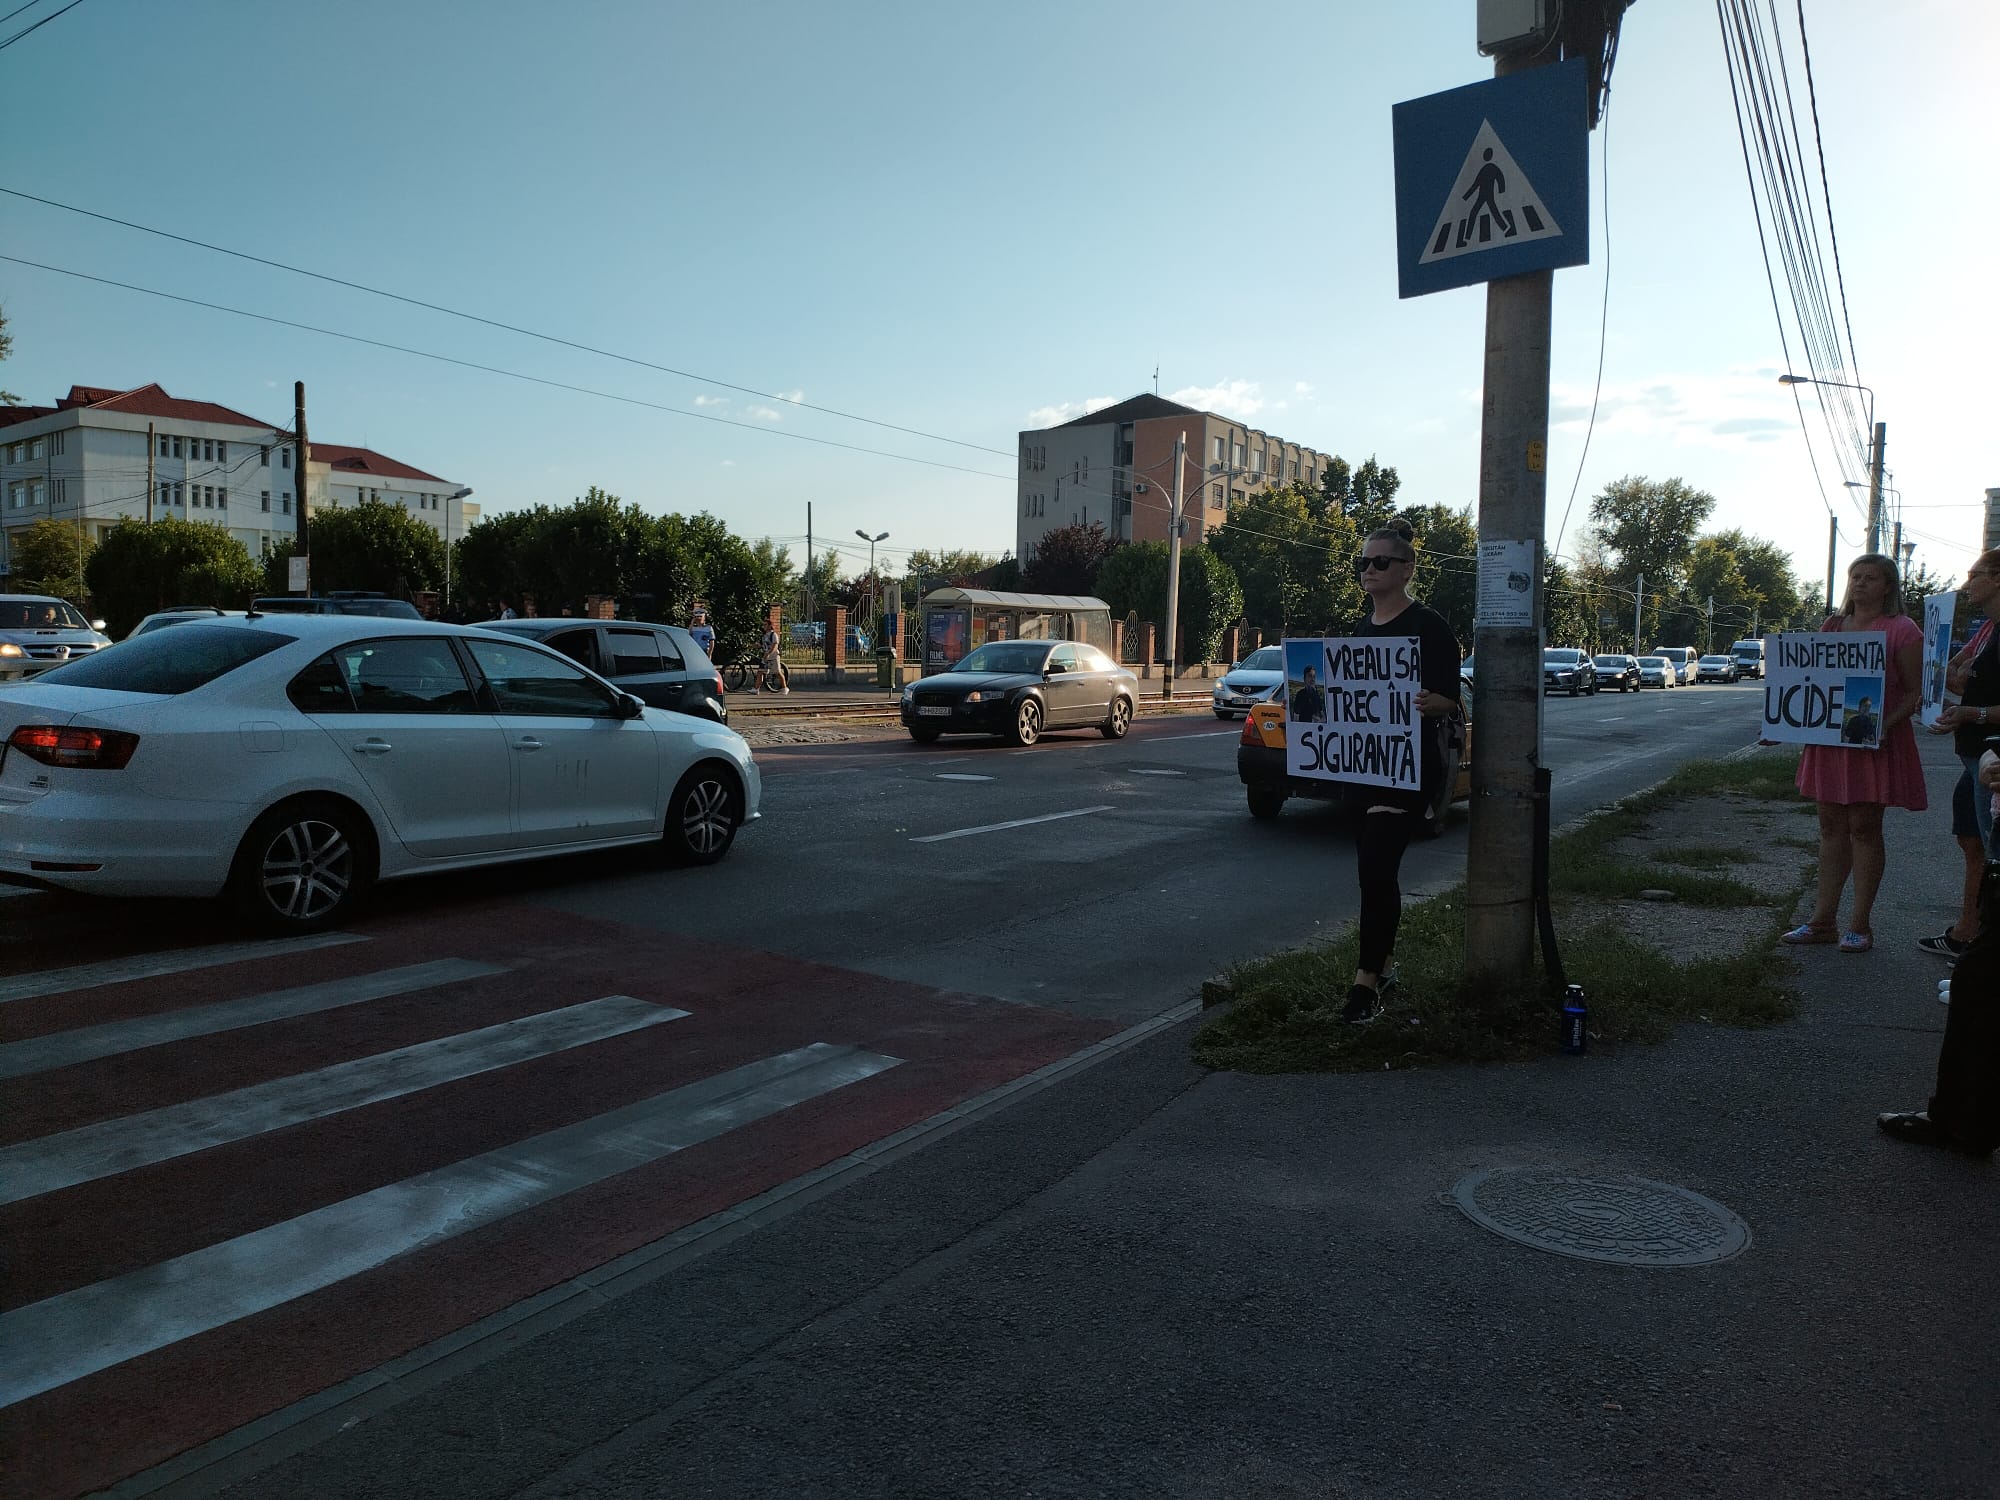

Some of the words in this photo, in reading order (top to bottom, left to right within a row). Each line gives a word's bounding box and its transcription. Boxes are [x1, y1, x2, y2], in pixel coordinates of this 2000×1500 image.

[1326, 644, 1391, 681] VREAU
[1395, 638, 1421, 682] SĂ
[1328, 687, 1381, 724] TREC
[1388, 681, 1411, 726] ÎN
[1765, 676, 1845, 729] UCIDE
[1300, 725, 1417, 786] SIGURANȚĂ
